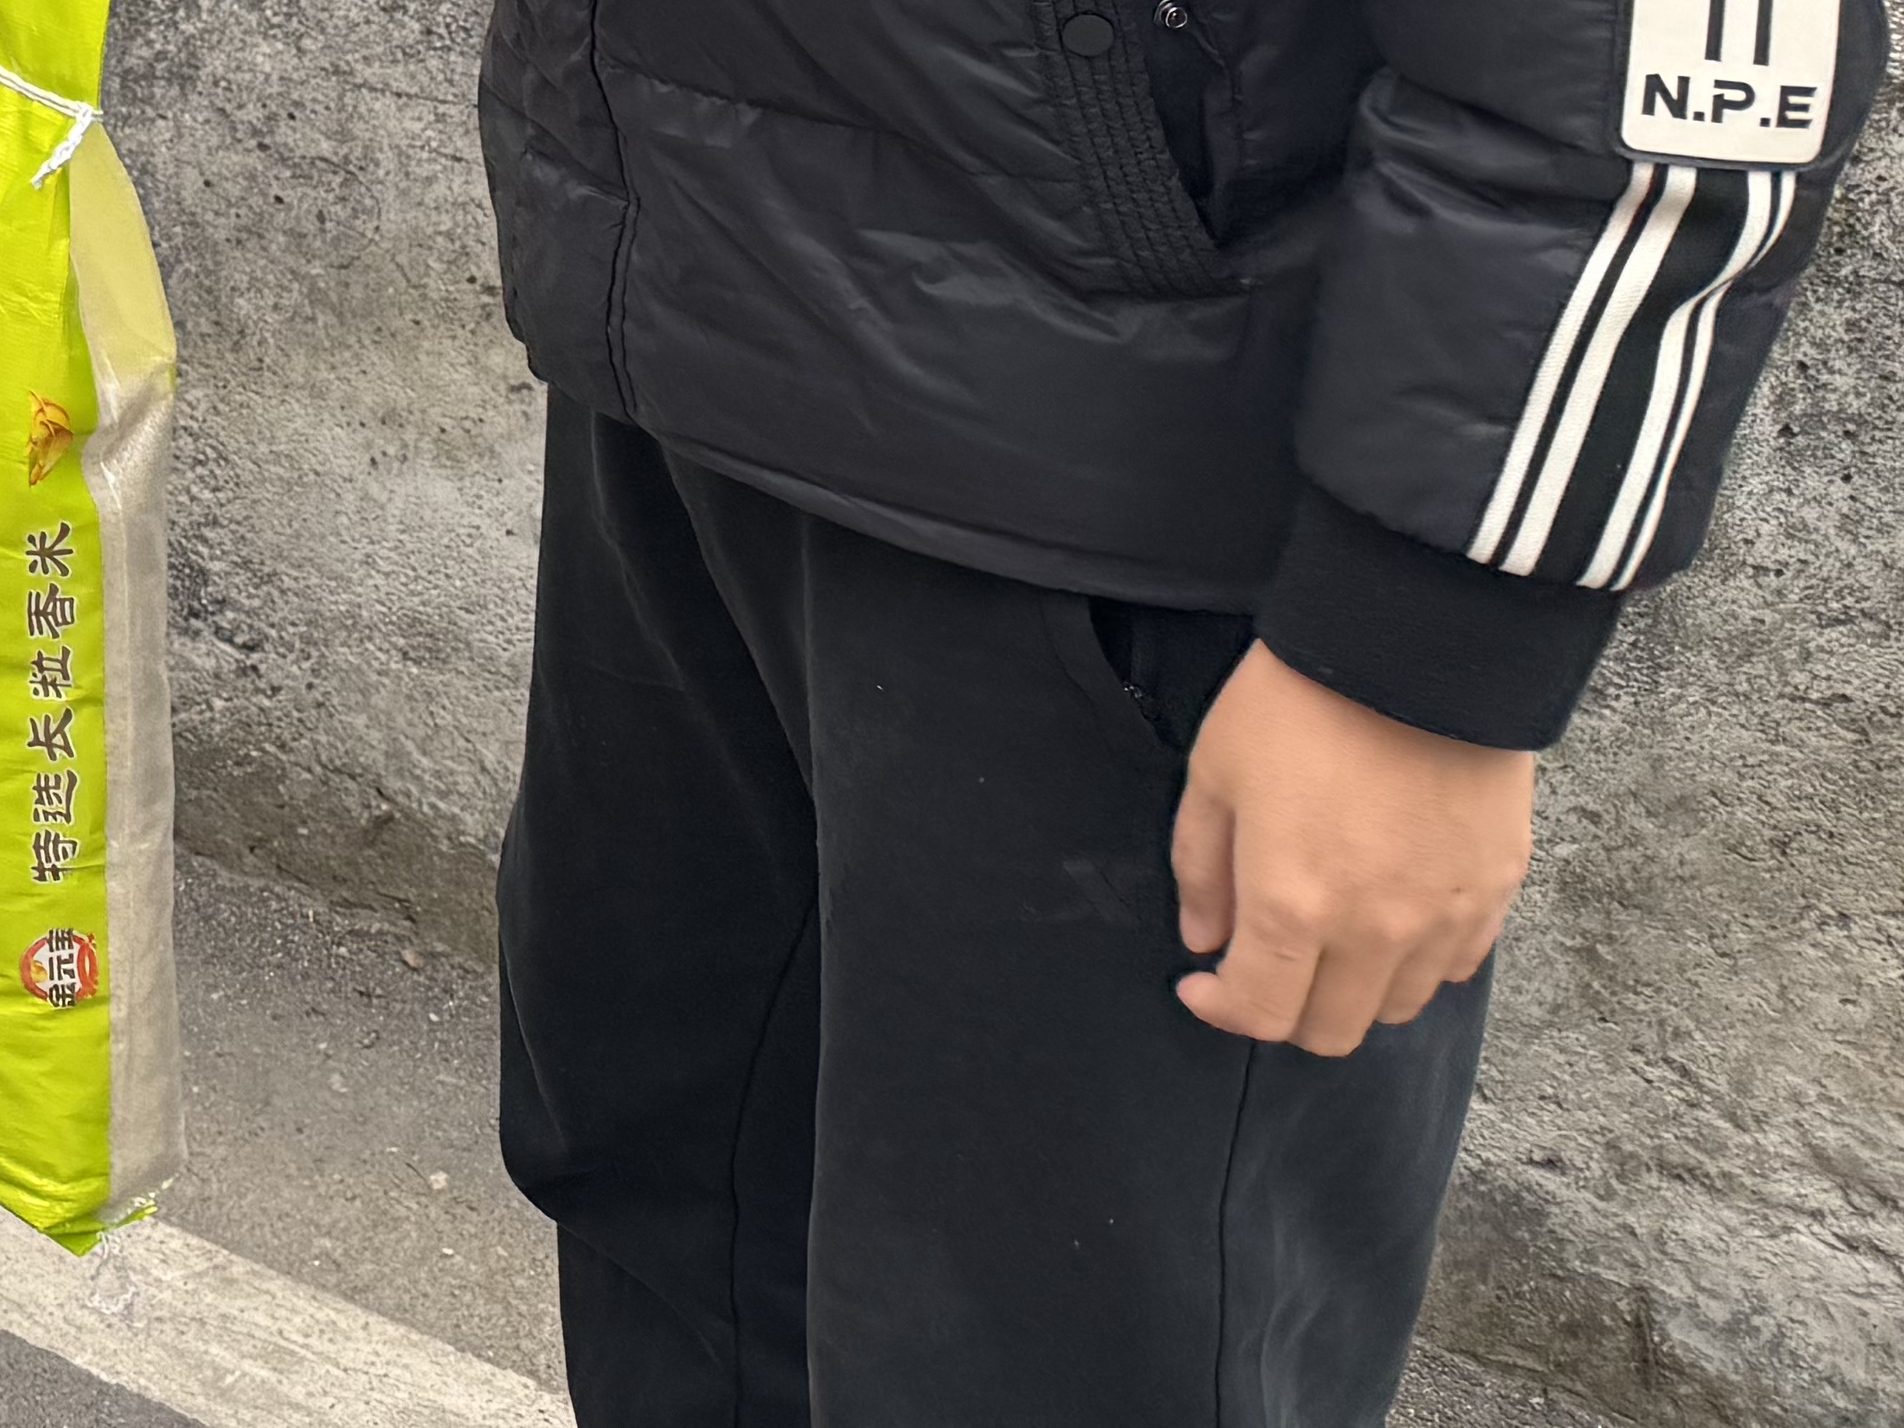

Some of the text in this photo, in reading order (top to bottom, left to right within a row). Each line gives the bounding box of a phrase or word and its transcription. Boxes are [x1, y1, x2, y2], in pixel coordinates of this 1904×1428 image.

[1641, 73, 1818, 129] N.P.E
[25, 521, 79, 884] 特选长粒香米
[46, 927, 77, 1009] 金元宝
